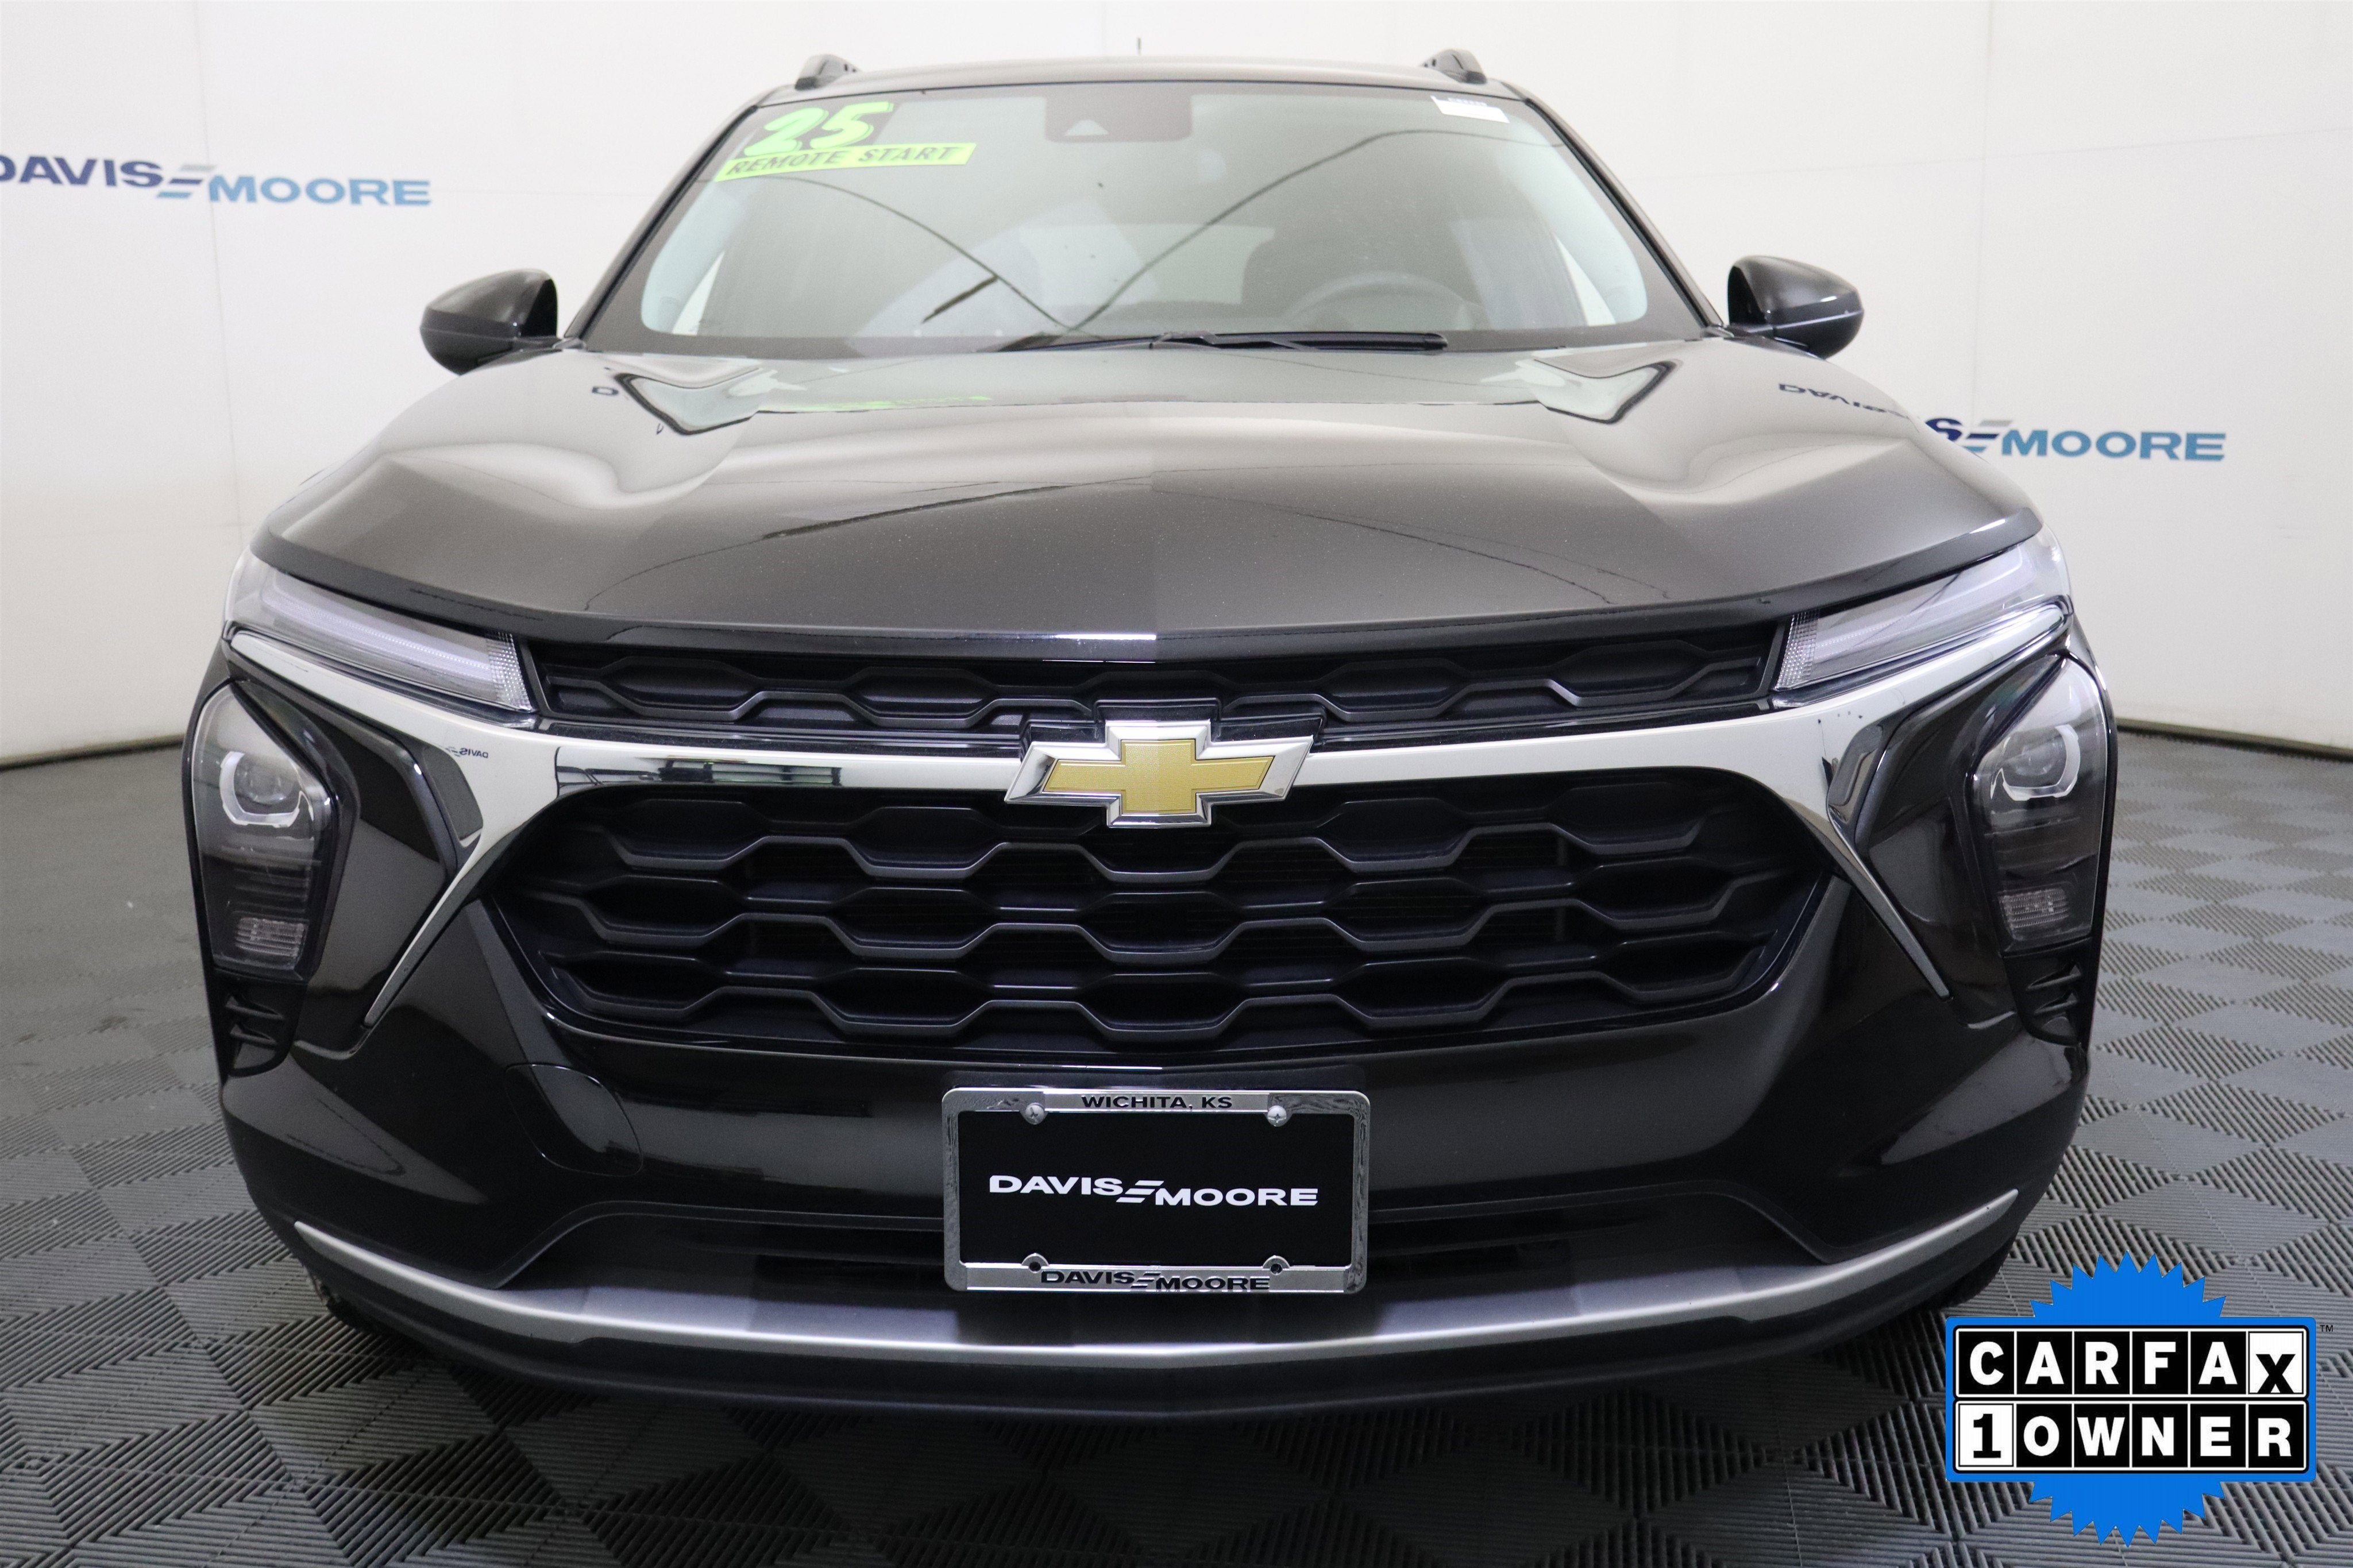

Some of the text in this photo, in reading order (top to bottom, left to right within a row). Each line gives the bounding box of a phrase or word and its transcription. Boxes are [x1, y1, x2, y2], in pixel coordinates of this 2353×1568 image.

[745, 101, 894, 156] 25
[727, 147, 955, 175] REMOTE START
[207, 175, 432, 206] MOORE
[2001, 428, 2227, 461] MOORE
[1081, 1096, 1232, 1109] WICHITA, KS
[989, 1175, 1318, 1206] DAVIS MOORE
[1040, 1271, 1270, 1291] DAVIS MOORE
